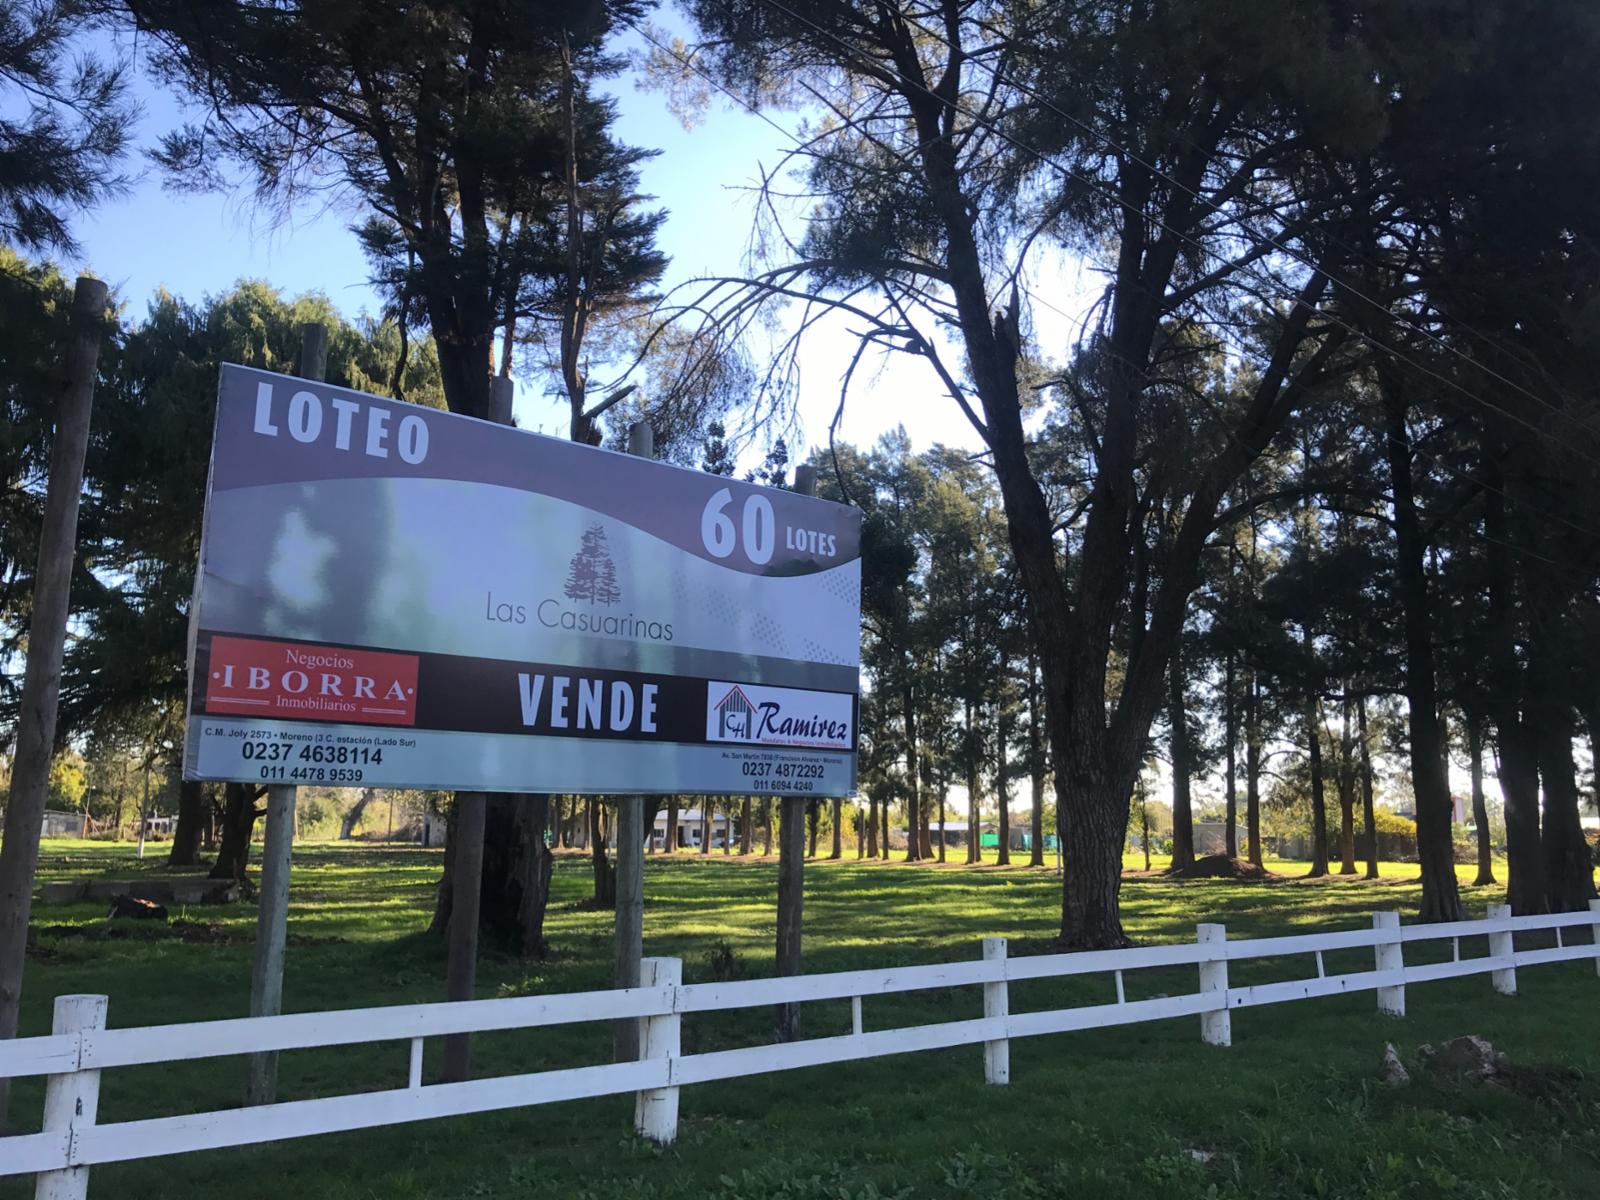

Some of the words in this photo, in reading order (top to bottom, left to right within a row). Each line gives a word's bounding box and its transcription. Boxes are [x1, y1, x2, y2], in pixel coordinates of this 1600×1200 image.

[254, 382, 429, 464] LOTEO
[702, 488, 775, 565] 60
[786, 526, 836, 557] LOTES
[486, 591, 526, 624] Las
[537, 599, 673, 641] Casuarinas
[286, 649, 354, 669] Negocios
[221, 664, 407, 701] IBORRA
[276, 694, 357, 712] Inmobiliarios
[517, 672, 659, 733] VENDE
[756, 702, 847, 740] Ramirez
[205, 727, 225, 737] C.M.
[228, 729, 248, 739] Joly
[250, 730, 271, 739] 2573
[280, 732, 313, 741] Moreno
[337, 736, 372, 745] estación
[374, 737, 397, 747] (Lado
[399, 738, 416, 748] Sur)
[242, 741, 293, 761] 0237
[299, 745, 383, 765] 4638114
[260, 765, 285, 779] 011
[290, 767, 325, 780] 4478
[330, 769, 363, 782] 9539
[742, 761, 772, 776] 0237
[775, 763, 824, 778] 4872292
[754, 780, 769, 790] 011
[793, 781, 813, 791] 4240
